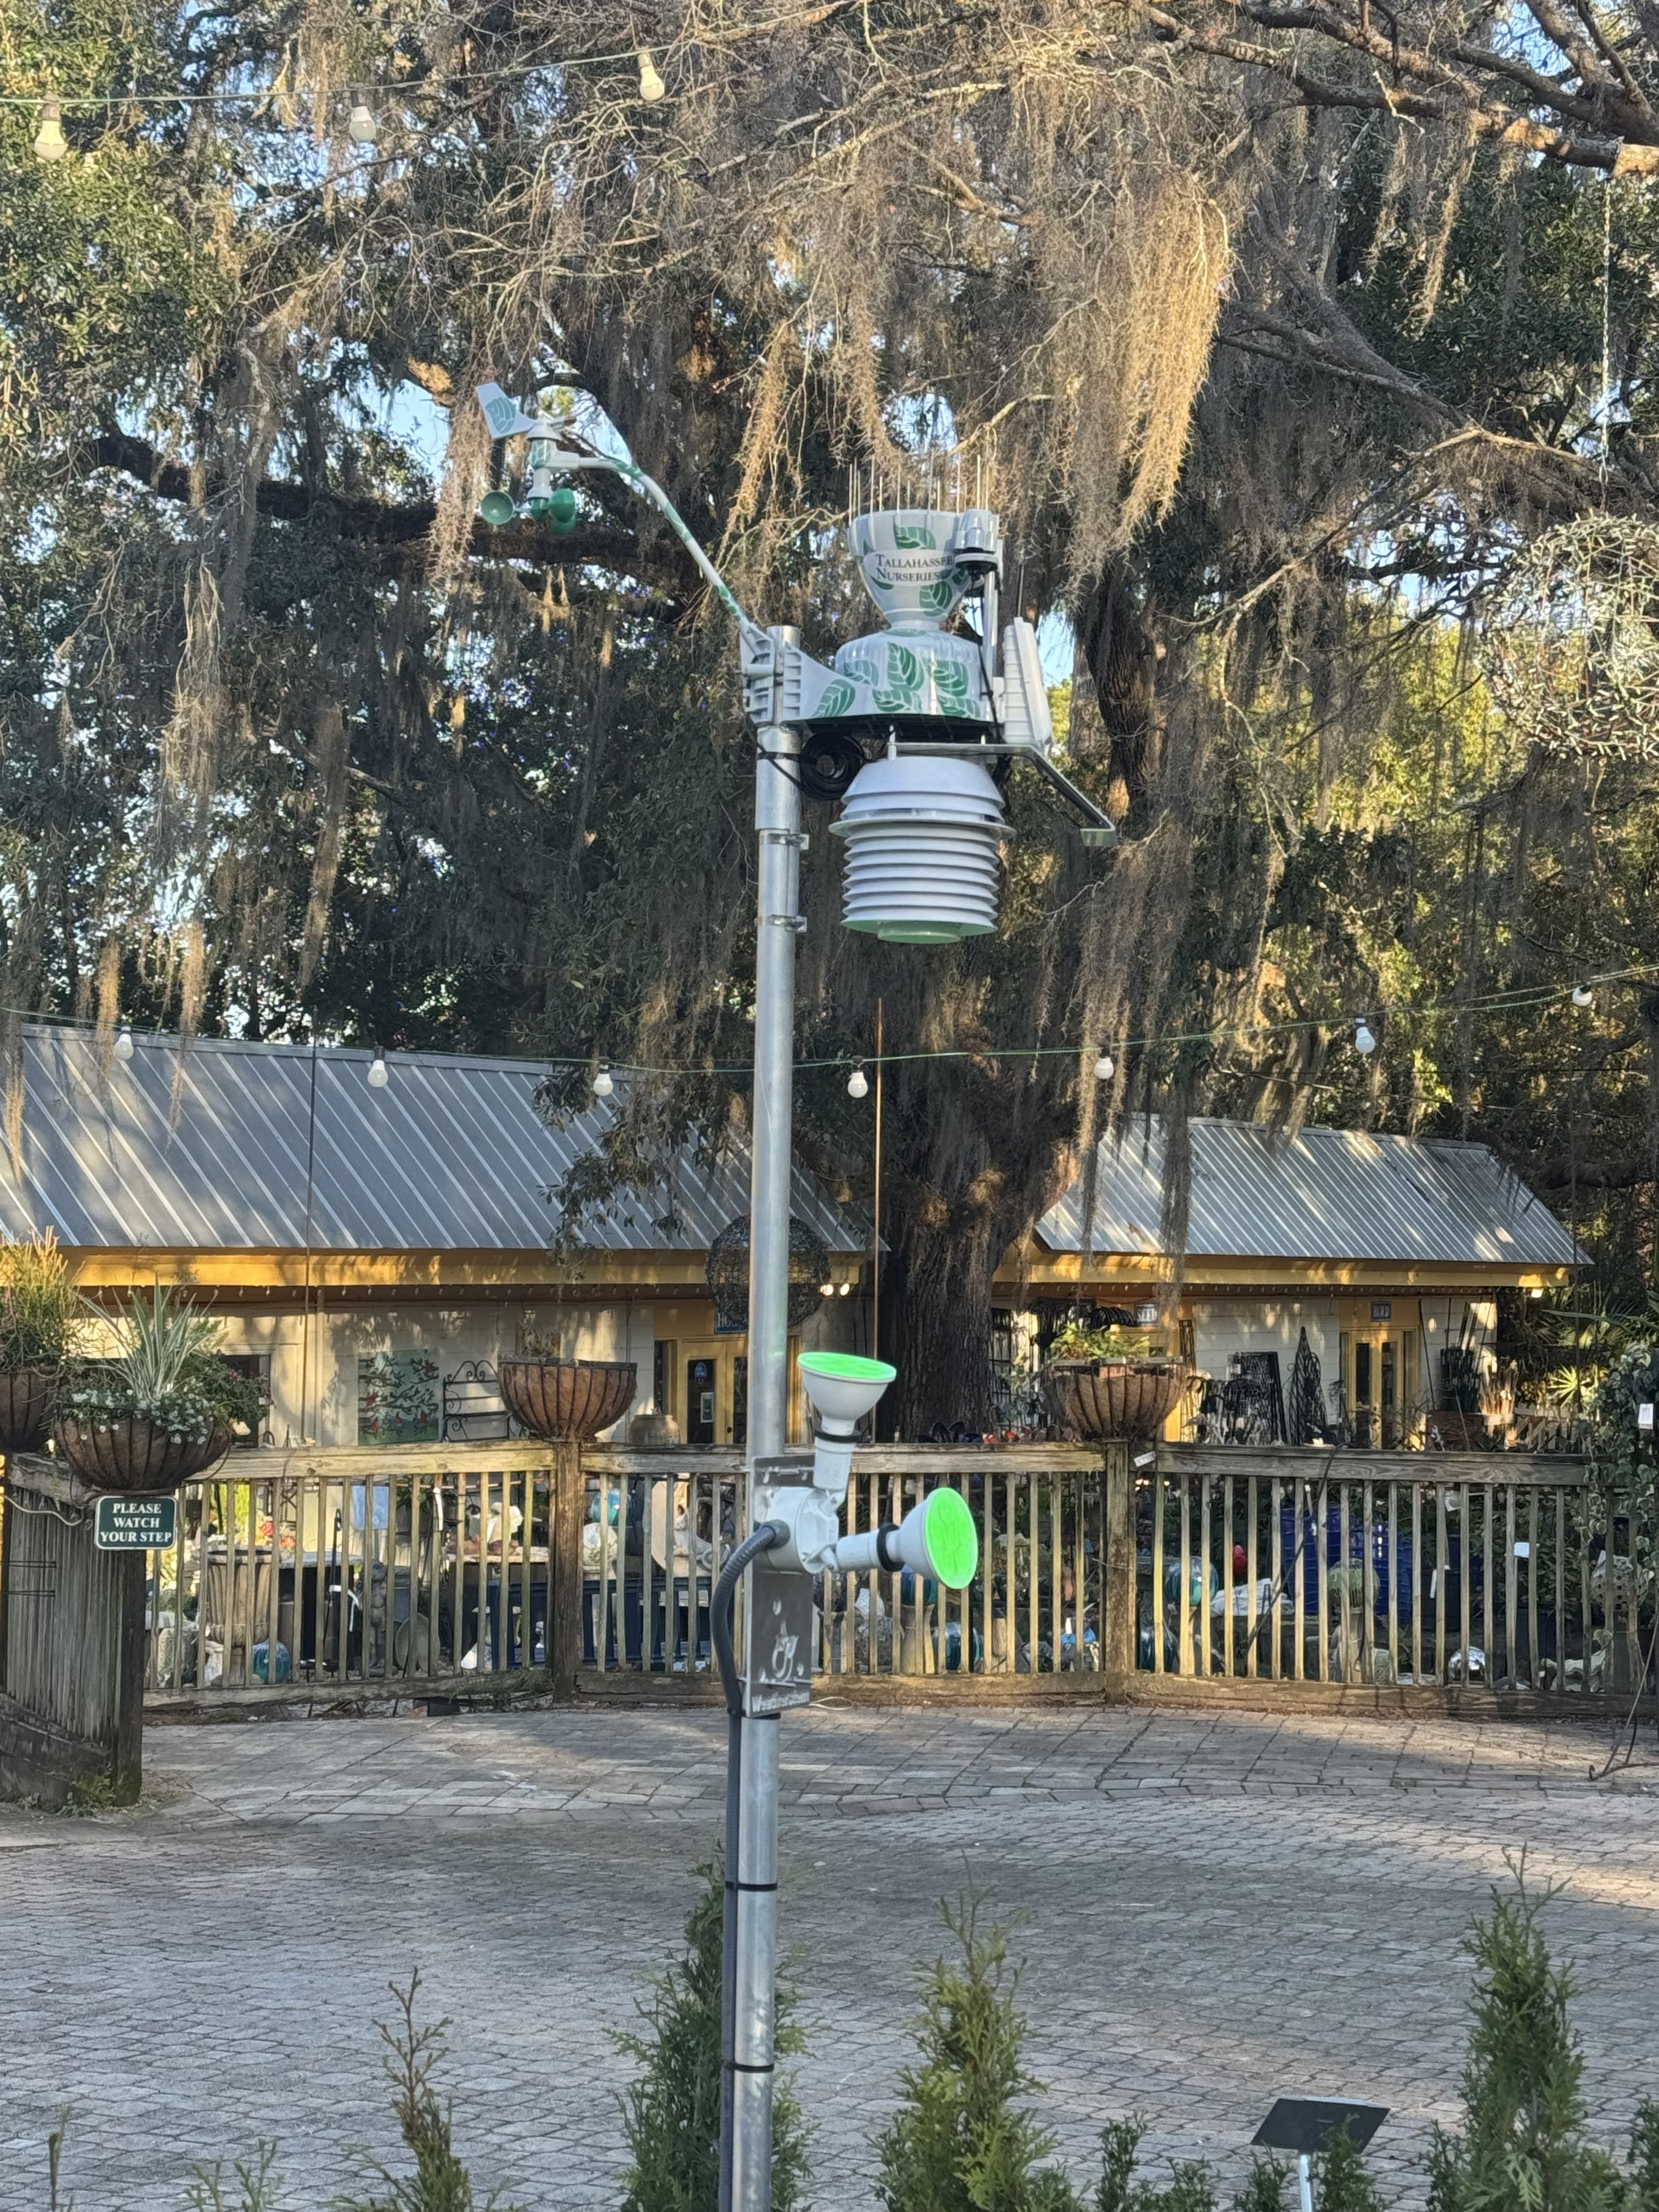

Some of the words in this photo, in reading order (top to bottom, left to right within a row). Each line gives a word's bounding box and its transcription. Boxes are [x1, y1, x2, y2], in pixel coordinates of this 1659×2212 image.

[876, 567, 940, 582] NURSERIES
[1373, 1305, 1390, 1317] BIRD
[112, 1503, 162, 1514] PLEASE
[113, 1517, 160, 1528] WATCH
[100, 1531, 137, 1542] YOUR
[139, 1532, 172, 1543] STEP
